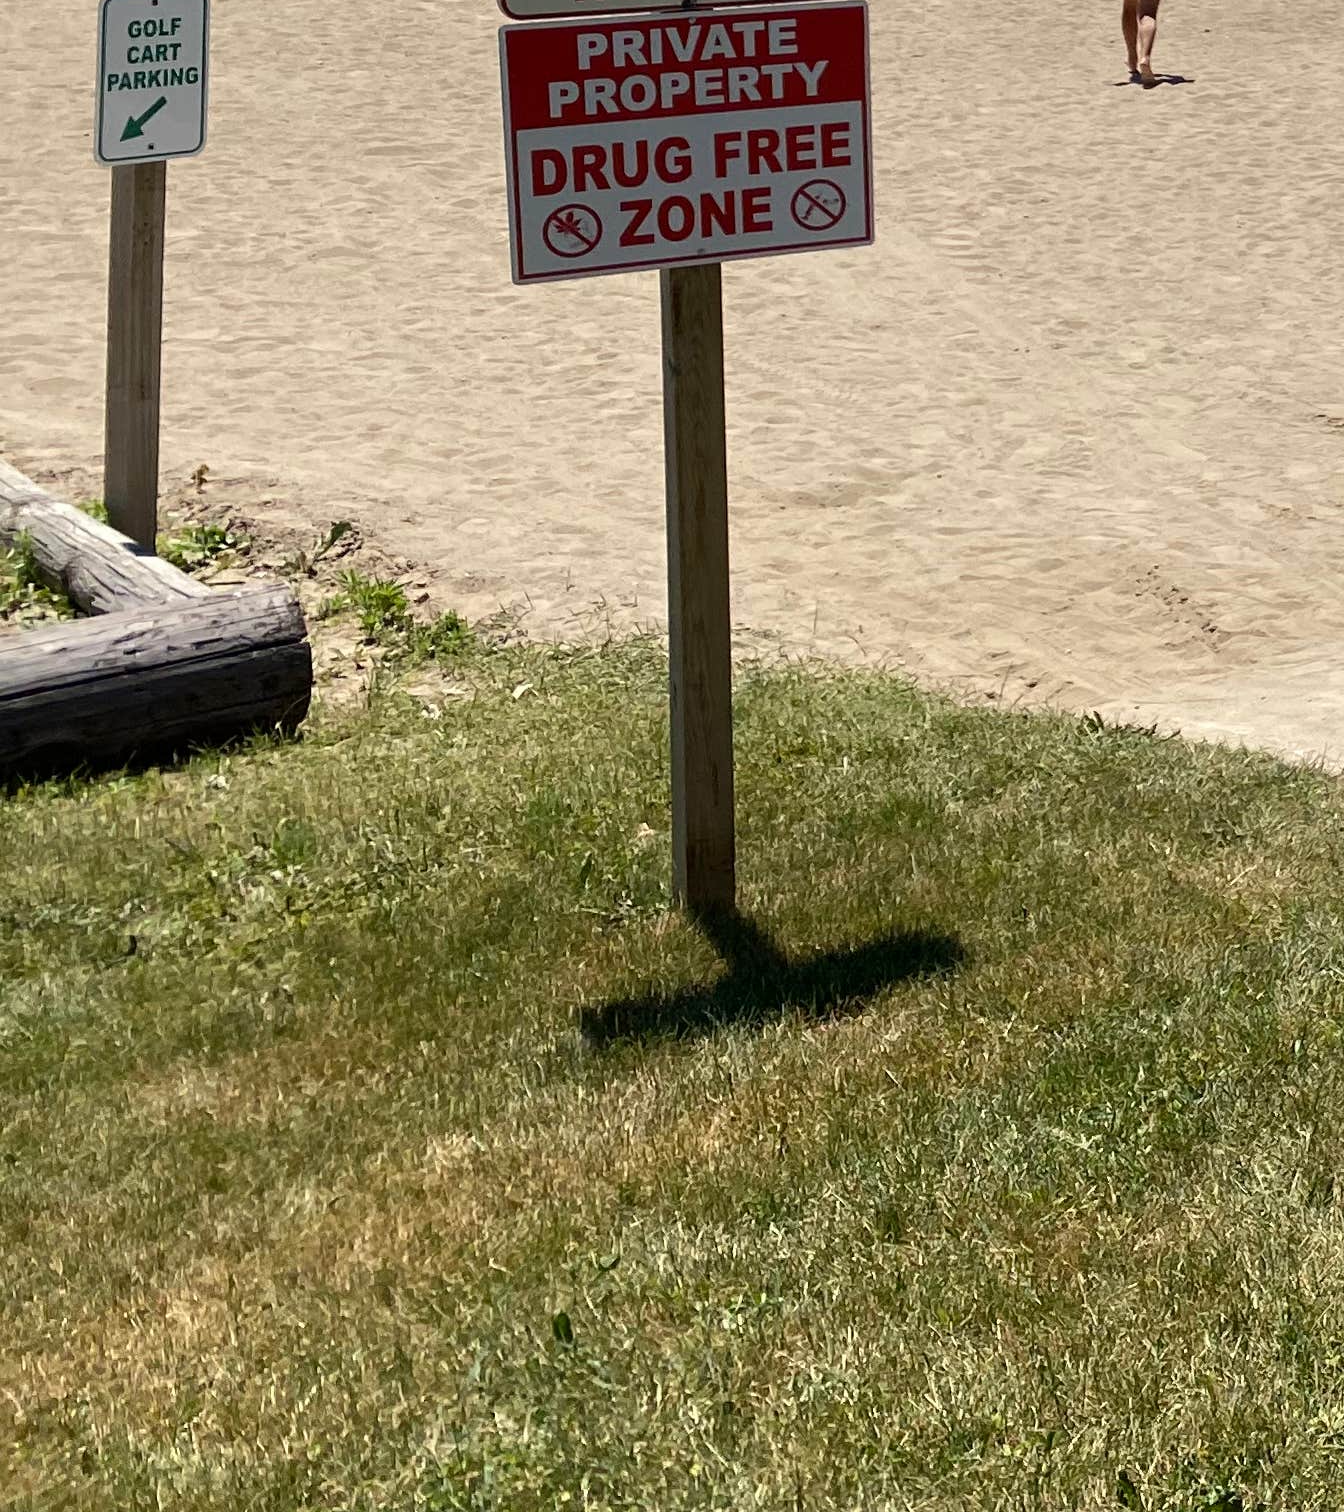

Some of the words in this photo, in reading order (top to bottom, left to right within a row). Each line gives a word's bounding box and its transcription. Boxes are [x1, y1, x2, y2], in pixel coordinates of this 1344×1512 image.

[127, 43, 182, 64] CART
[128, 18, 182, 38] GOLF
[577, 19, 799, 71] PRIVATE
[107, 67, 199, 92] PARKING
[547, 60, 831, 118] PROPERTY
[530, 136, 692, 197] DRUG
[714, 122, 852, 179] FREE
[619, 187, 774, 247] ZONE
